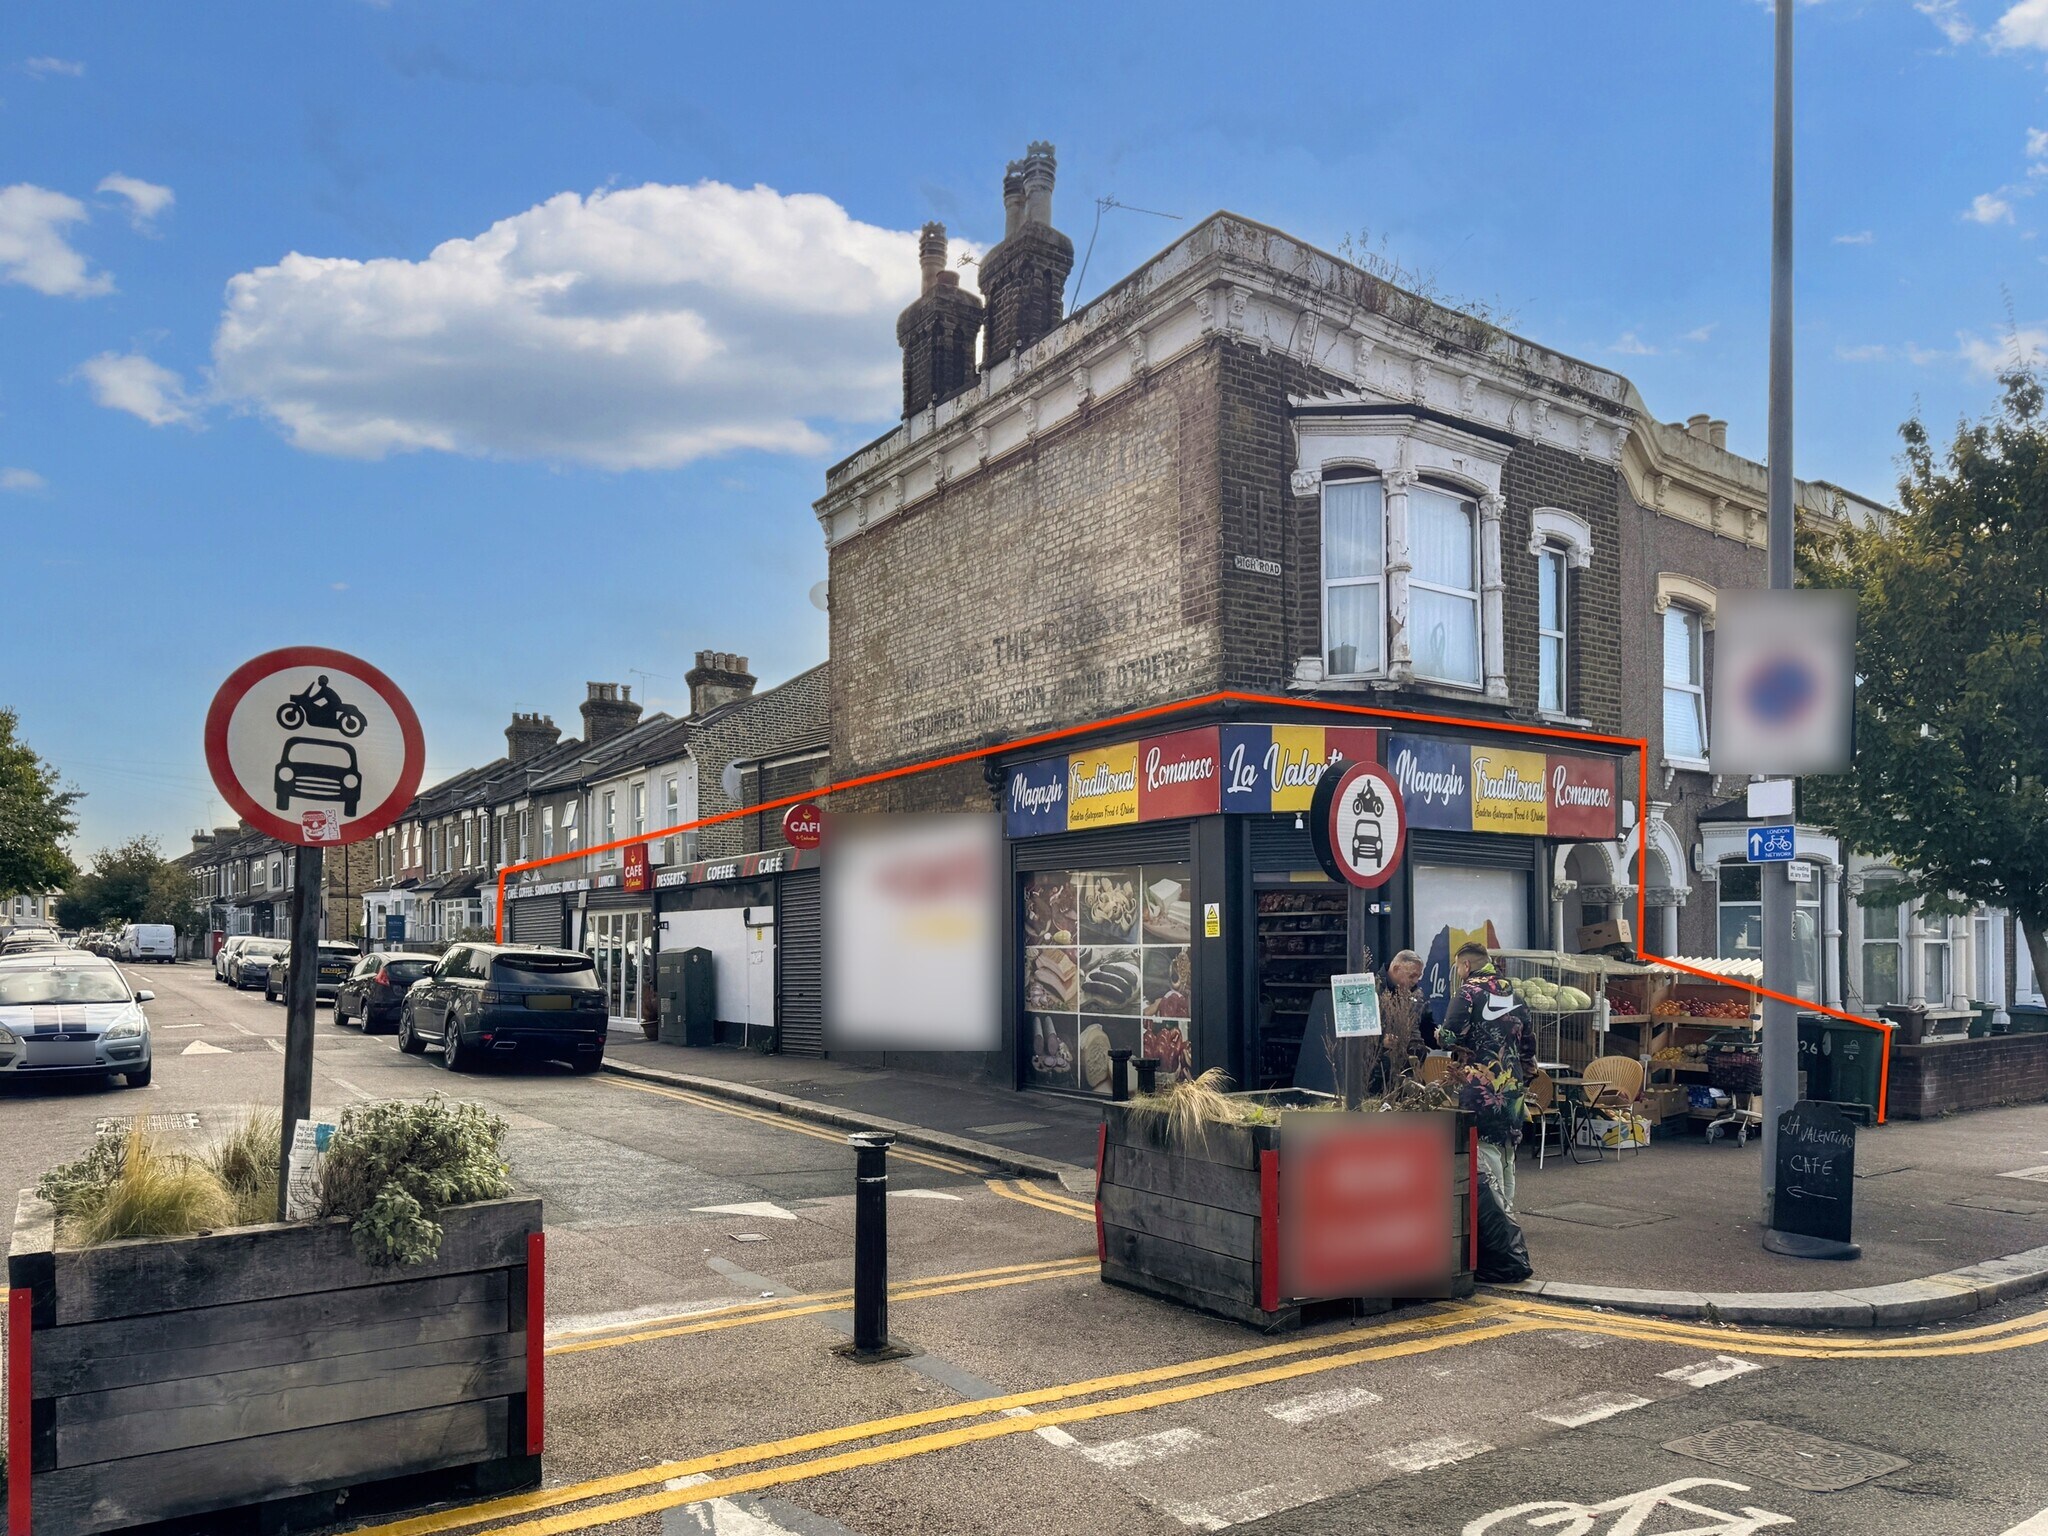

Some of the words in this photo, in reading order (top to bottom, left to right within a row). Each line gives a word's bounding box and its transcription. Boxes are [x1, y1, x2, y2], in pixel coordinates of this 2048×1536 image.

[1260, 561, 1280, 574] ROAD
[1226, 743, 1259, 794] La
[1395, 748, 1465, 807] Magazin
[1552, 764, 1611, 809] Românesc
[1012, 772, 1064, 816] Magazin
[1145, 746, 1216, 793] Românesc
[624, 860, 643, 878] CAFÉ
[707, 864, 735, 880] COFFEE
[758, 851, 784, 874] CAFÉ
[598, 874, 617, 888] LUNCH
[656, 871, 686, 887] DESSERTS
[1429, 962, 1447, 999] La
[1780, 1115, 1801, 1135] LA
[1790, 1154, 1833, 1175] CAFE
